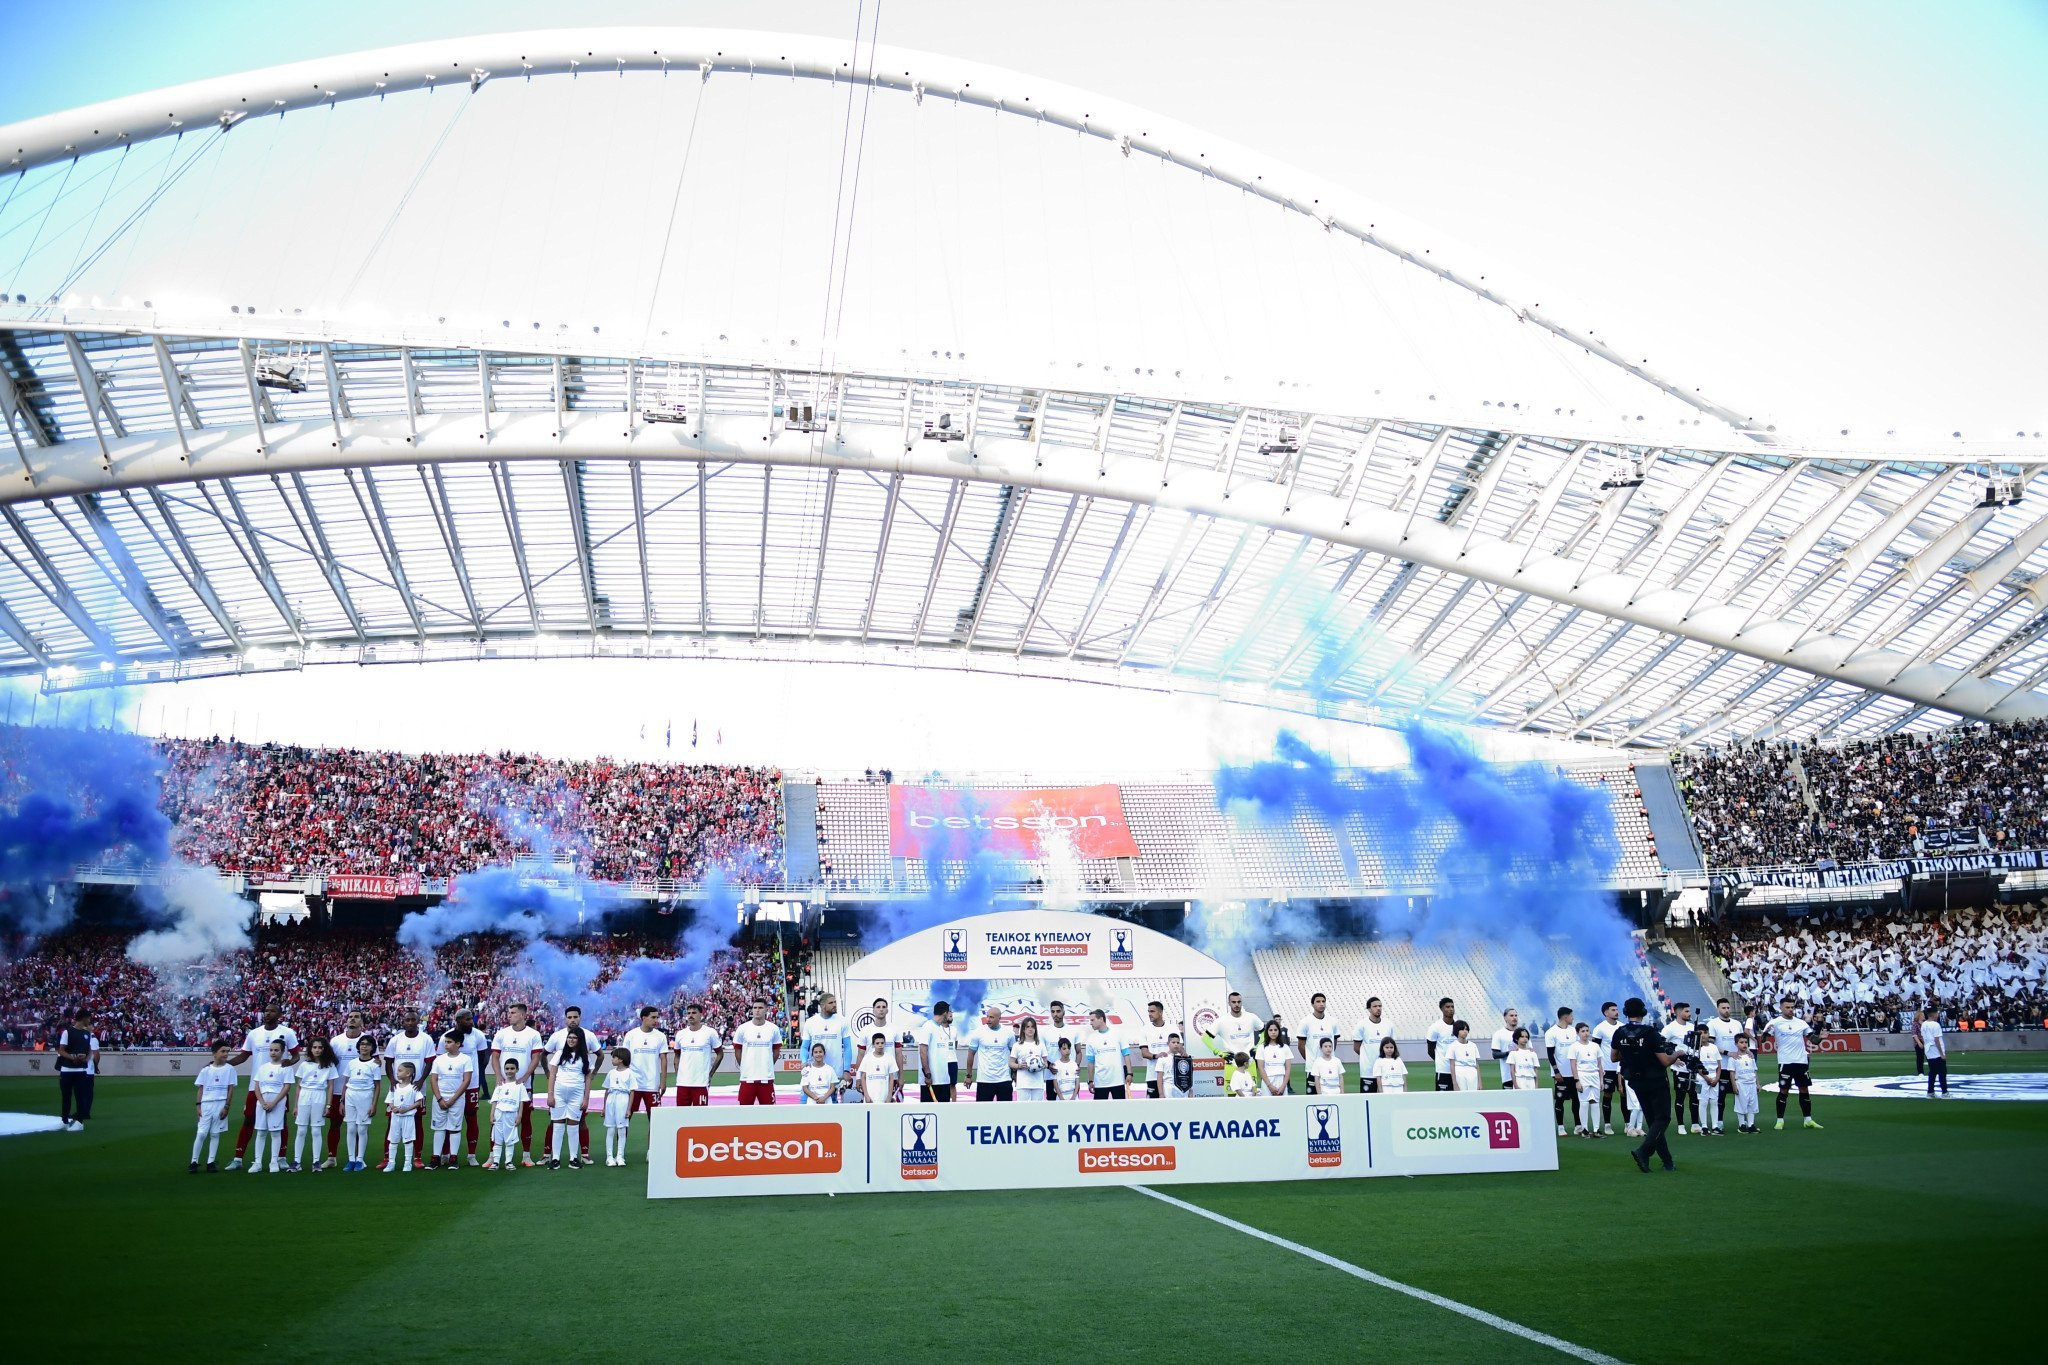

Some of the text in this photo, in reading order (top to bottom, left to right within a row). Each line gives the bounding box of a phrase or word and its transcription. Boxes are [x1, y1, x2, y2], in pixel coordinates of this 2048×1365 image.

[909, 811, 1107, 830] betsson
[2000, 851, 2037, 868] ΣΤΗΝ
[986, 932, 1092, 942] ΤΕΛΙΚΟΣ ΚΥΠΕΛΛΟΥ
[990, 945, 1083, 955] ΕΛΛΑΔΑΣ betsson
[1026, 960, 1053, 970] 2025
[699, 1094, 707, 1105] 14
[966, 1118, 1281, 1145] ΤΕΛΙΚΟΣ ΚΥΠΕΛΛΟΥ ΕΛΛΑΔΑΣ
[1406, 1126, 1480, 1141] COSMOTE
[1309, 1139, 1340, 1147] ΚΥΠΕΛΛΟ
[687, 1136, 824, 1163] betsson
[903, 1150, 937, 1158] ΚΥΠΕΛΛΟ
[1083, 1151, 1166, 1168] betsson
[1310, 1156, 1341, 1164] betsson
[903, 1168, 937, 1176] betsson
